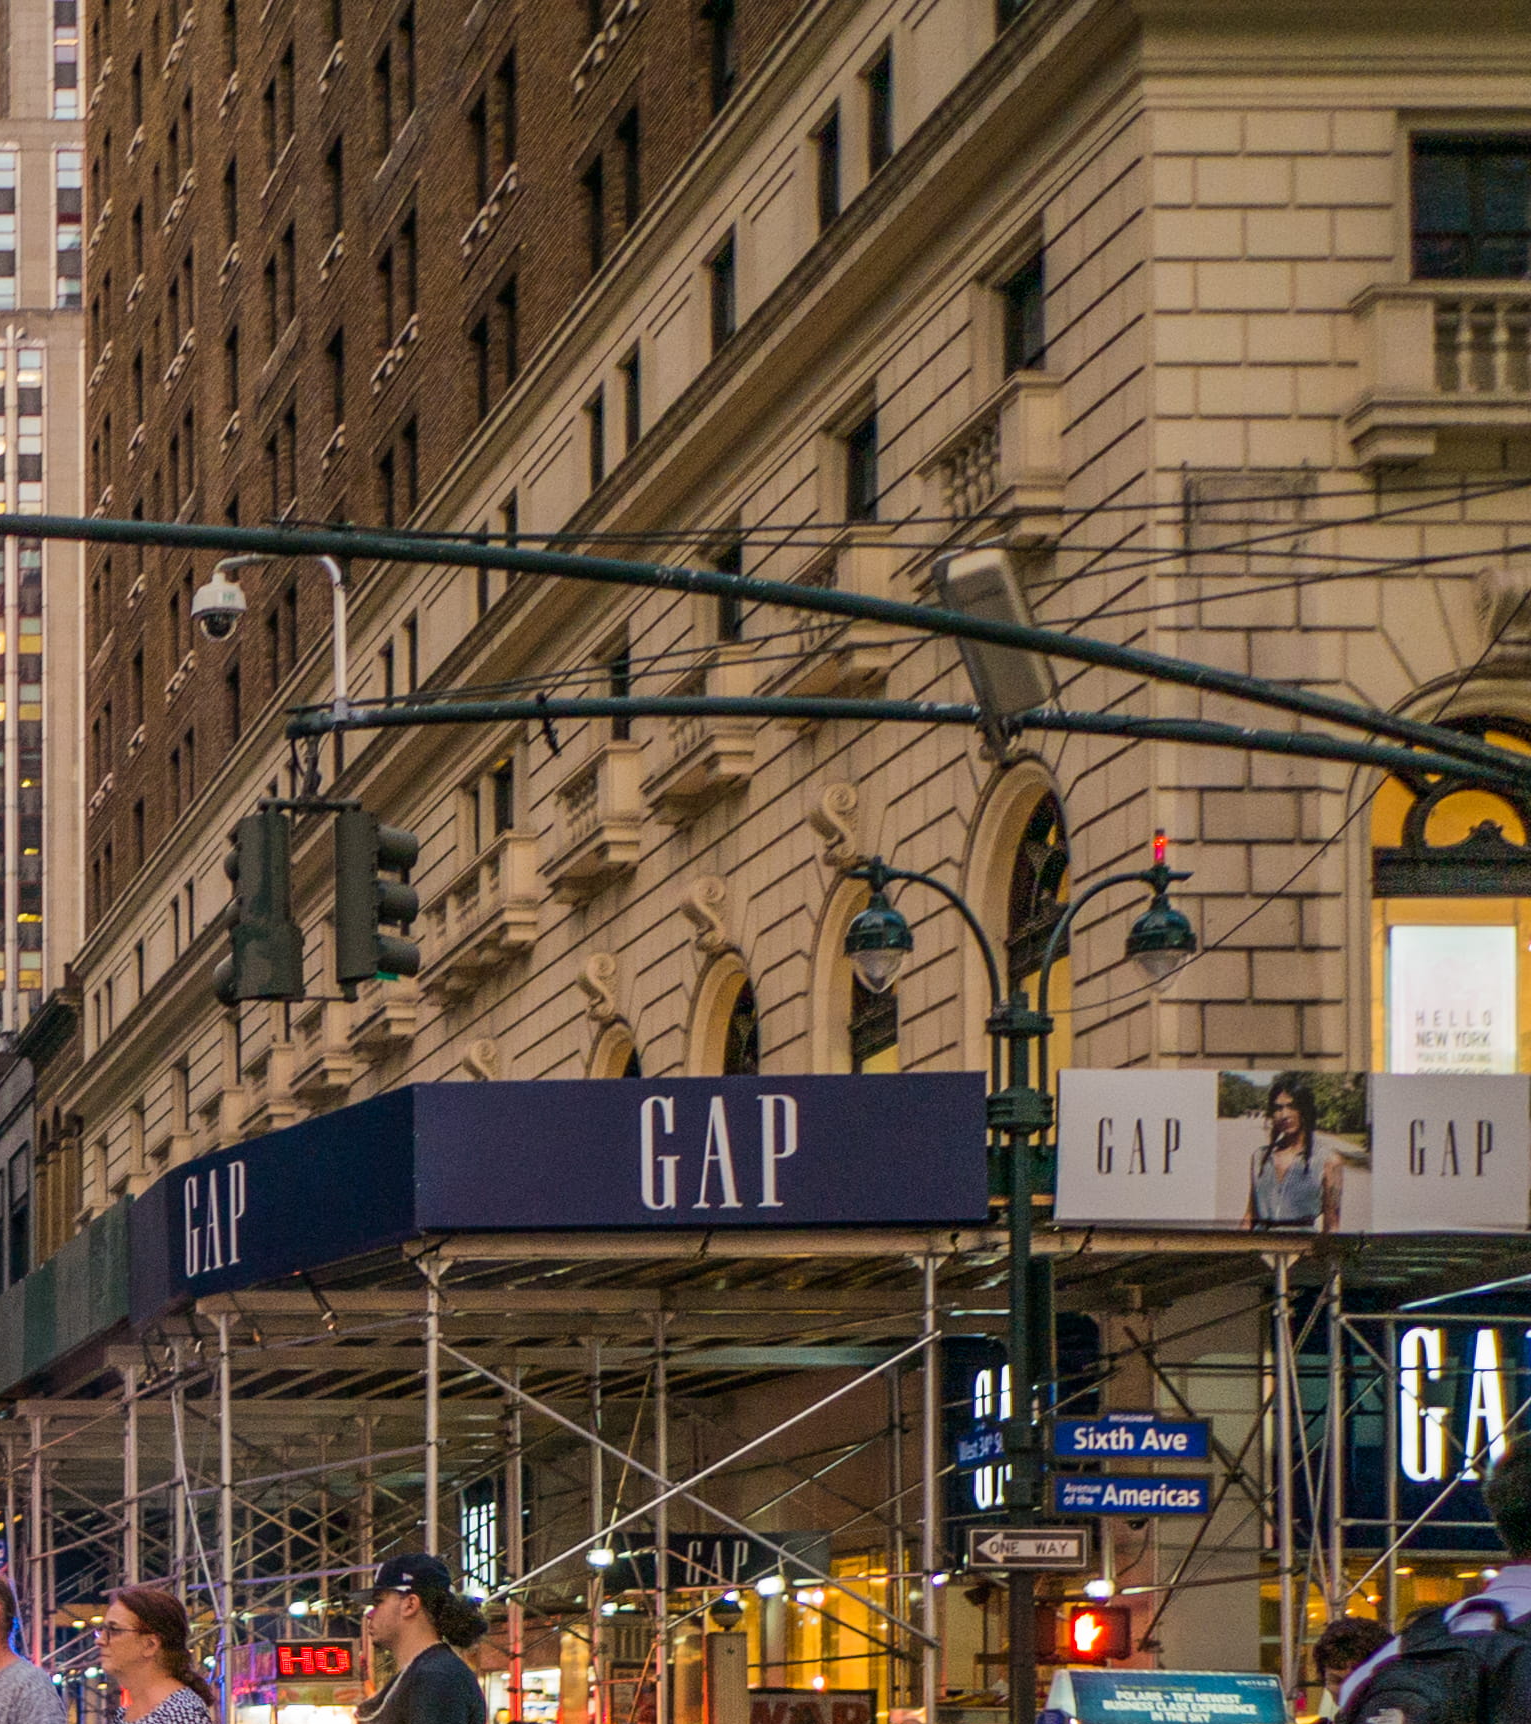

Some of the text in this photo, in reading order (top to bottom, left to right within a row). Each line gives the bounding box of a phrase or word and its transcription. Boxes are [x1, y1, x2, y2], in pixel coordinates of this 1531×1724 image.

[1415, 1010, 1492, 1027] HELLO
[1416, 1031, 1491, 1047] NEW YORK
[639, 1093, 798, 1211] GAP
[1096, 1116, 1181, 1175] GAP
[1409, 1119, 1493, 1177] GAP
[183, 1160, 246, 1279] GAP
[1400, 1326, 1531, 1483] GA
[1074, 1427, 1188, 1451] Sixth Ave
[1063, 1483, 1102, 1494] Avenue
[1063, 1493, 1094, 1505] of the
[1102, 1484, 1200, 1508] Americas
[989, 1541, 1069, 1555] ONE WAY
[687, 1540, 749, 1585] GAP
[279, 1646, 351, 1675] HO
[1102, 1699, 1257, 1715] BUSINESS CLASS EXPERIENCE
[1115, 1690, 1164, 1701] POLARIS
[1171, 1692, 1194, 1703] THE
[1194, 1693, 1241, 1704] NEWEST
[1150, 1711, 1211, 1723] IN THE SKY
